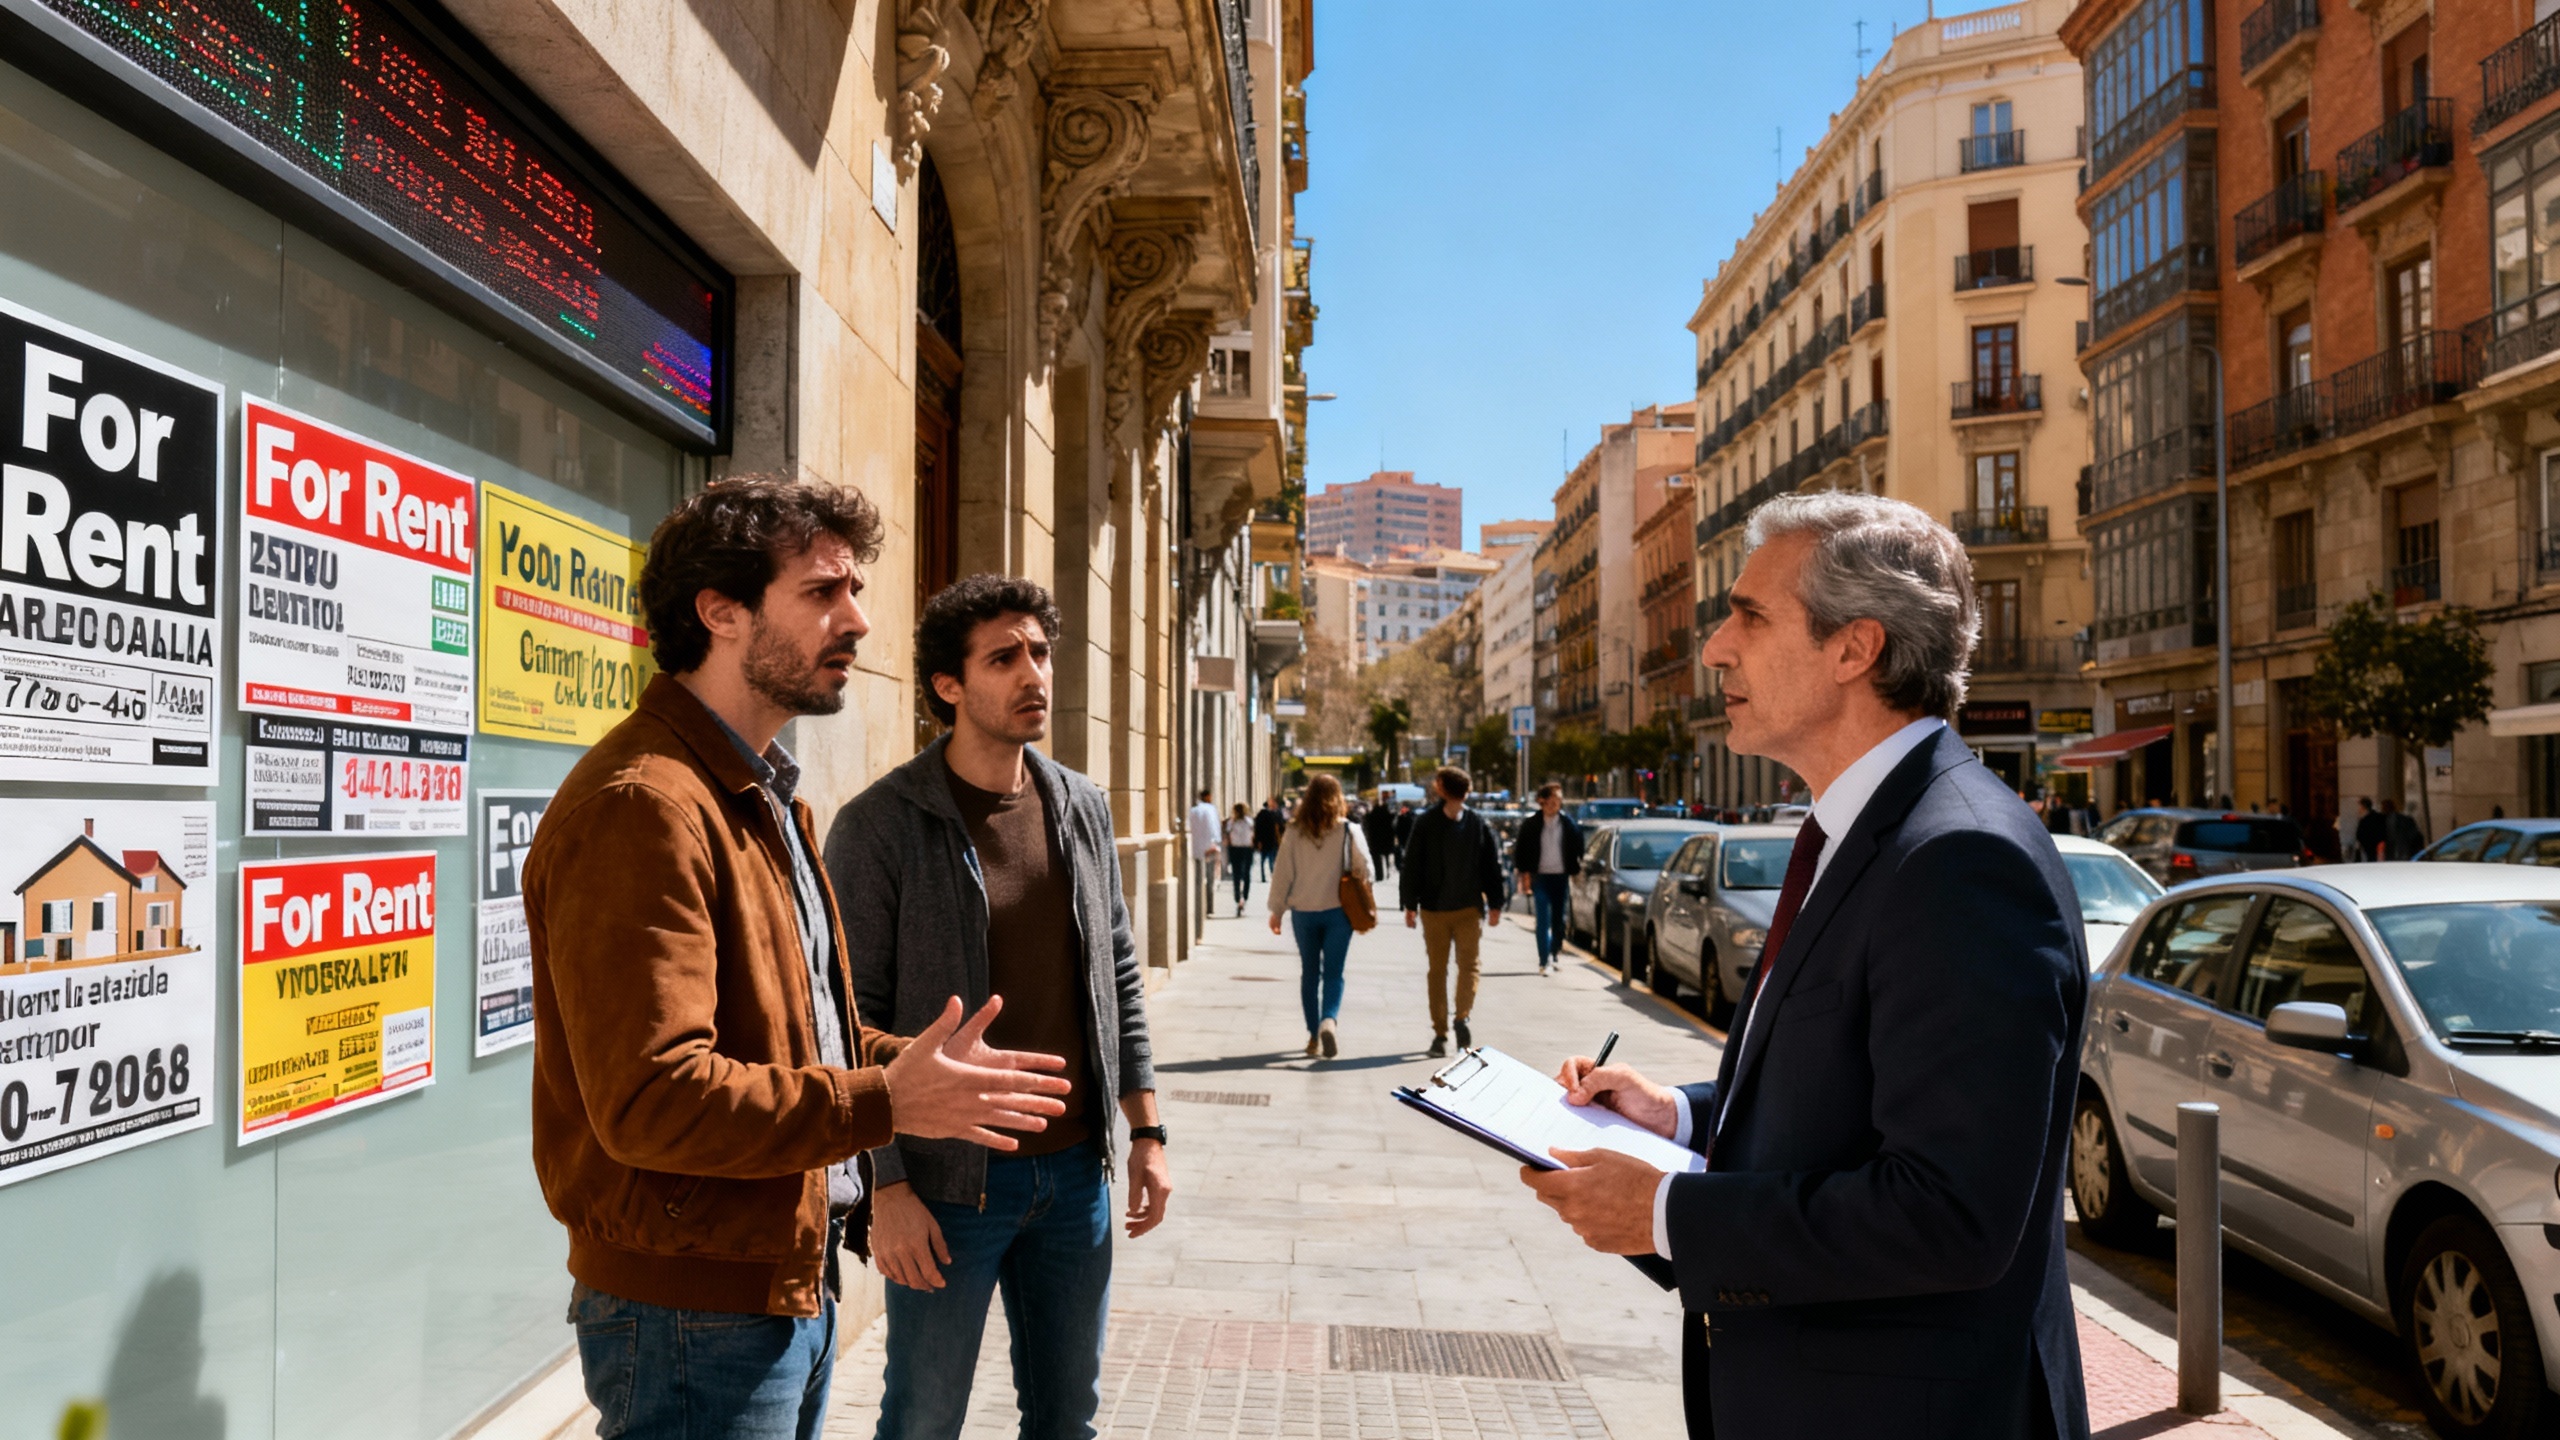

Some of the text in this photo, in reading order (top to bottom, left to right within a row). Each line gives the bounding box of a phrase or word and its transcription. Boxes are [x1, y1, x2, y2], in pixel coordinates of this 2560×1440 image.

[23, 341, 175, 482] For
[1, 463, 206, 606] Rent
[256, 422, 472, 564] For Rent
[252, 877, 331, 952] For
[343, 871, 433, 938] Rent
